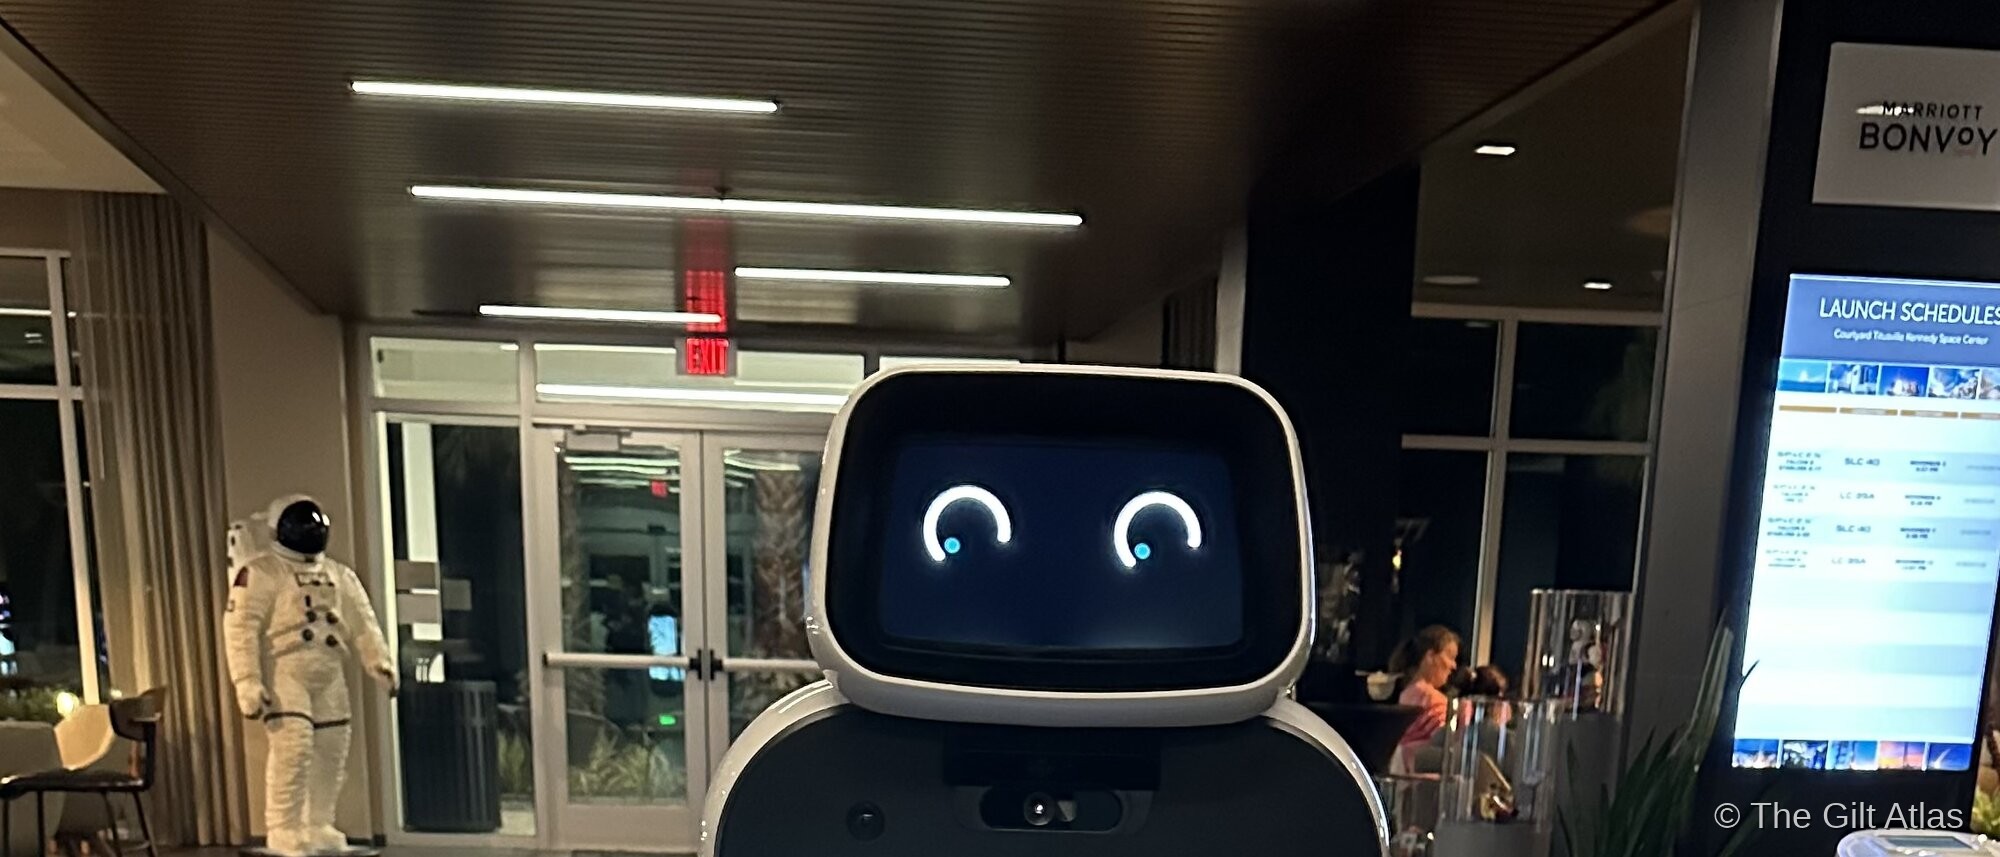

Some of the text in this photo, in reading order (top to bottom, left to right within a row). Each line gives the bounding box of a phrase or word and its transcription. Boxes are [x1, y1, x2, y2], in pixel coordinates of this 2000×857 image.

[1882, 101, 1983, 121] MARRIOTT
[1859, 121, 1998, 156] BONVOY
[1819, 297, 2000, 326] LAUNCH SCHEDULES
[686, 338, 729, 375] EXIT
